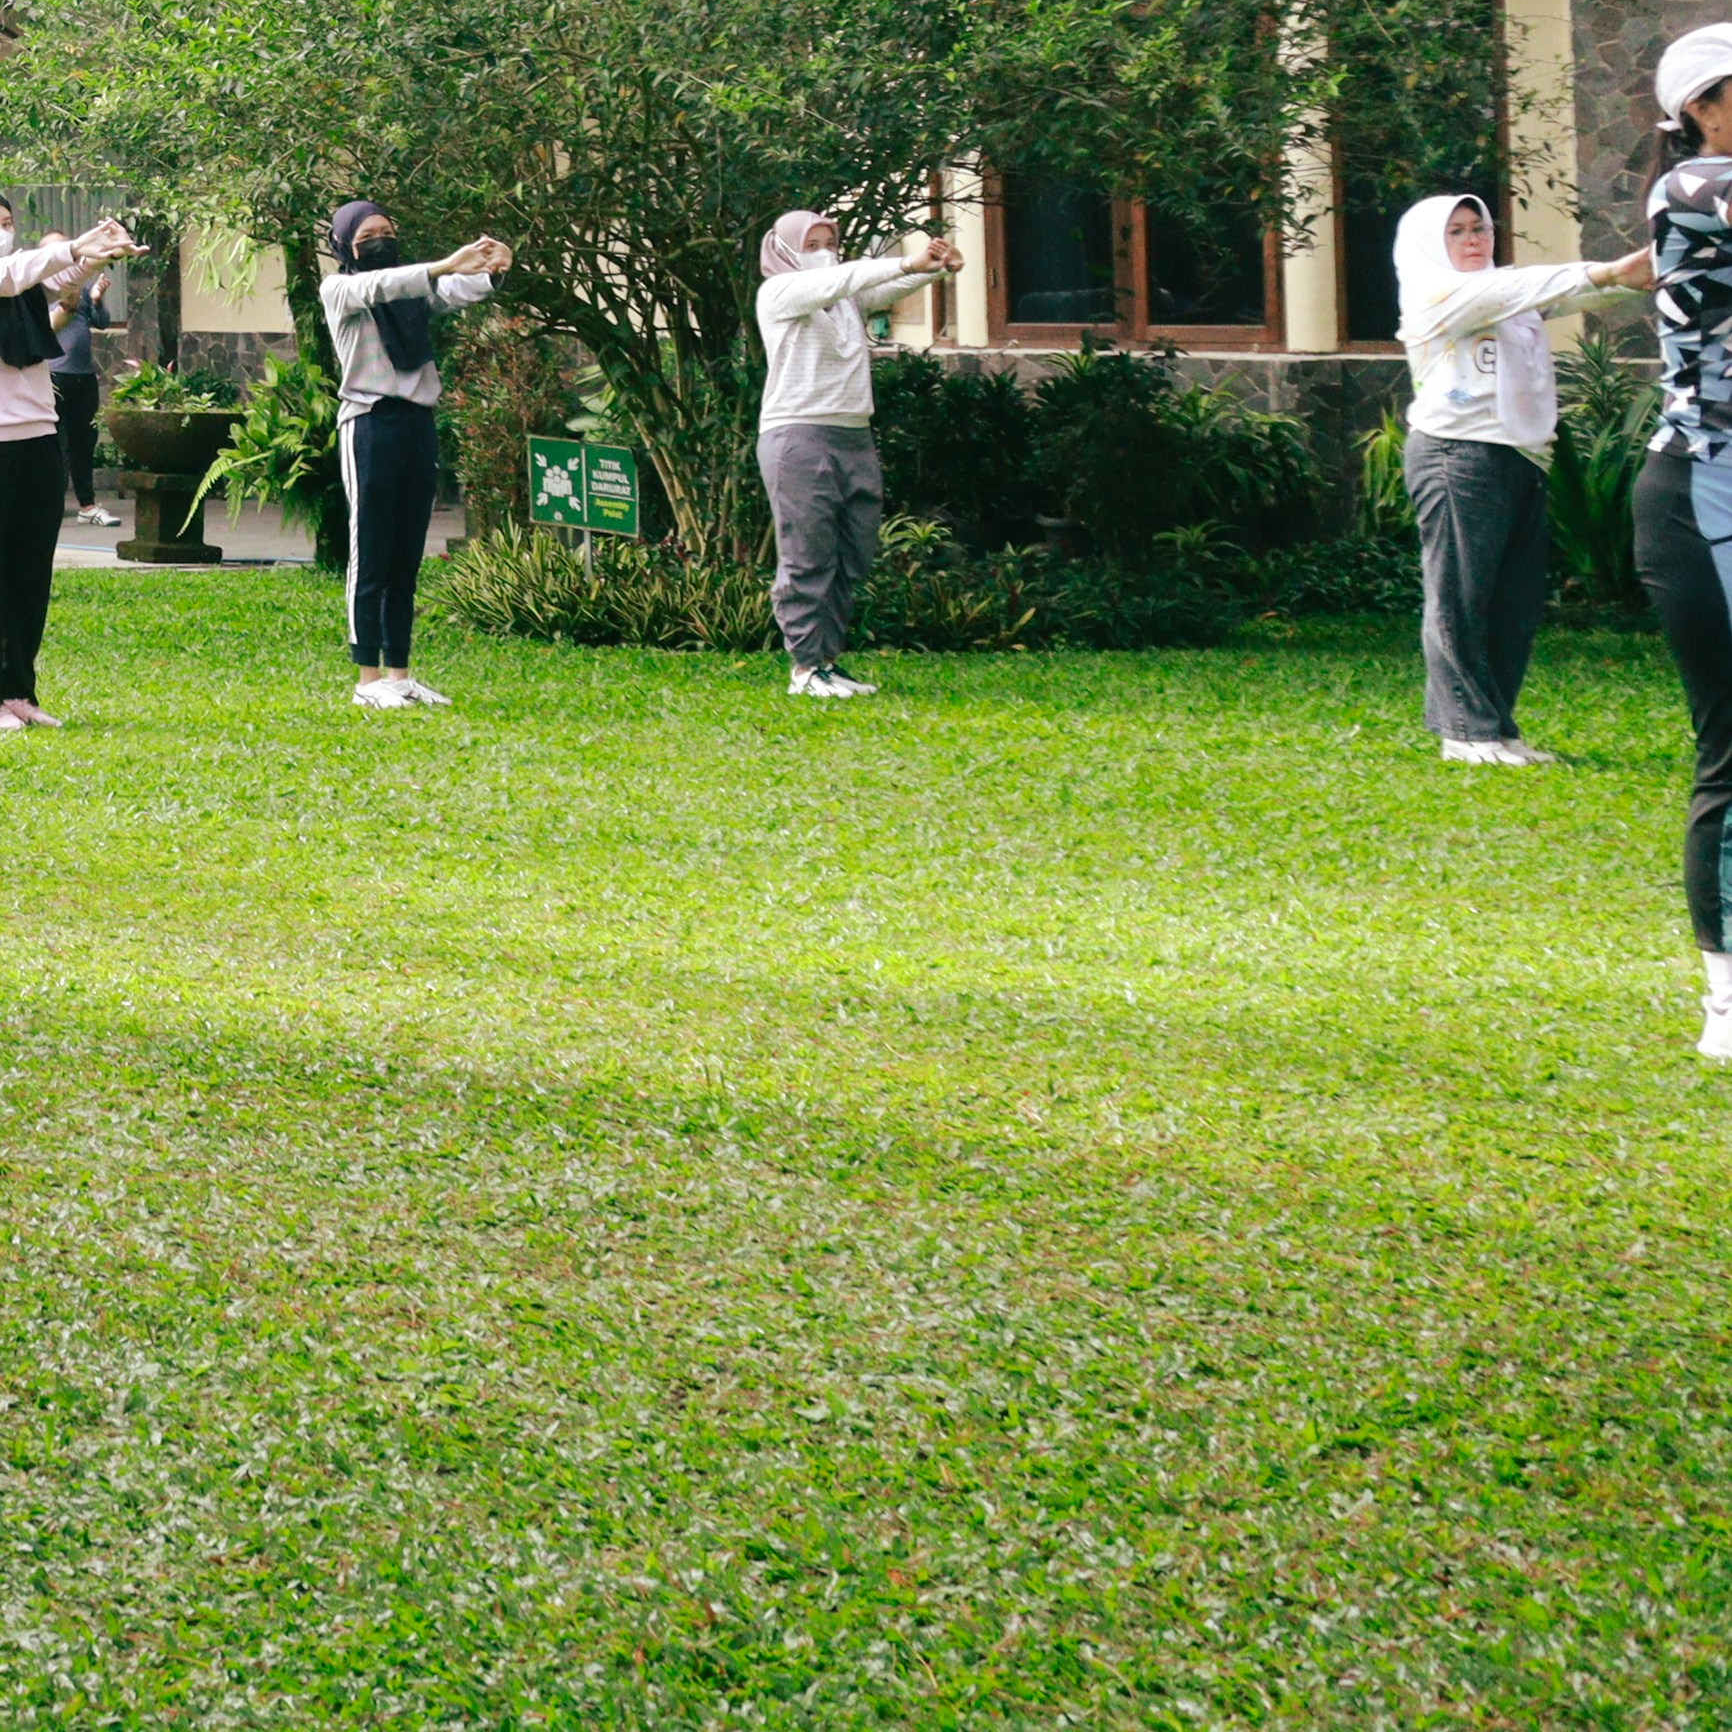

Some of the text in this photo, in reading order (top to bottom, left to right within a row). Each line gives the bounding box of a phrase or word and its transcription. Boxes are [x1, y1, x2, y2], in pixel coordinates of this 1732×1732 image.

[598, 458, 622, 471] TITIK
[592, 469, 630, 484] KUMPUL
[591, 480, 632, 496] DARURAT
